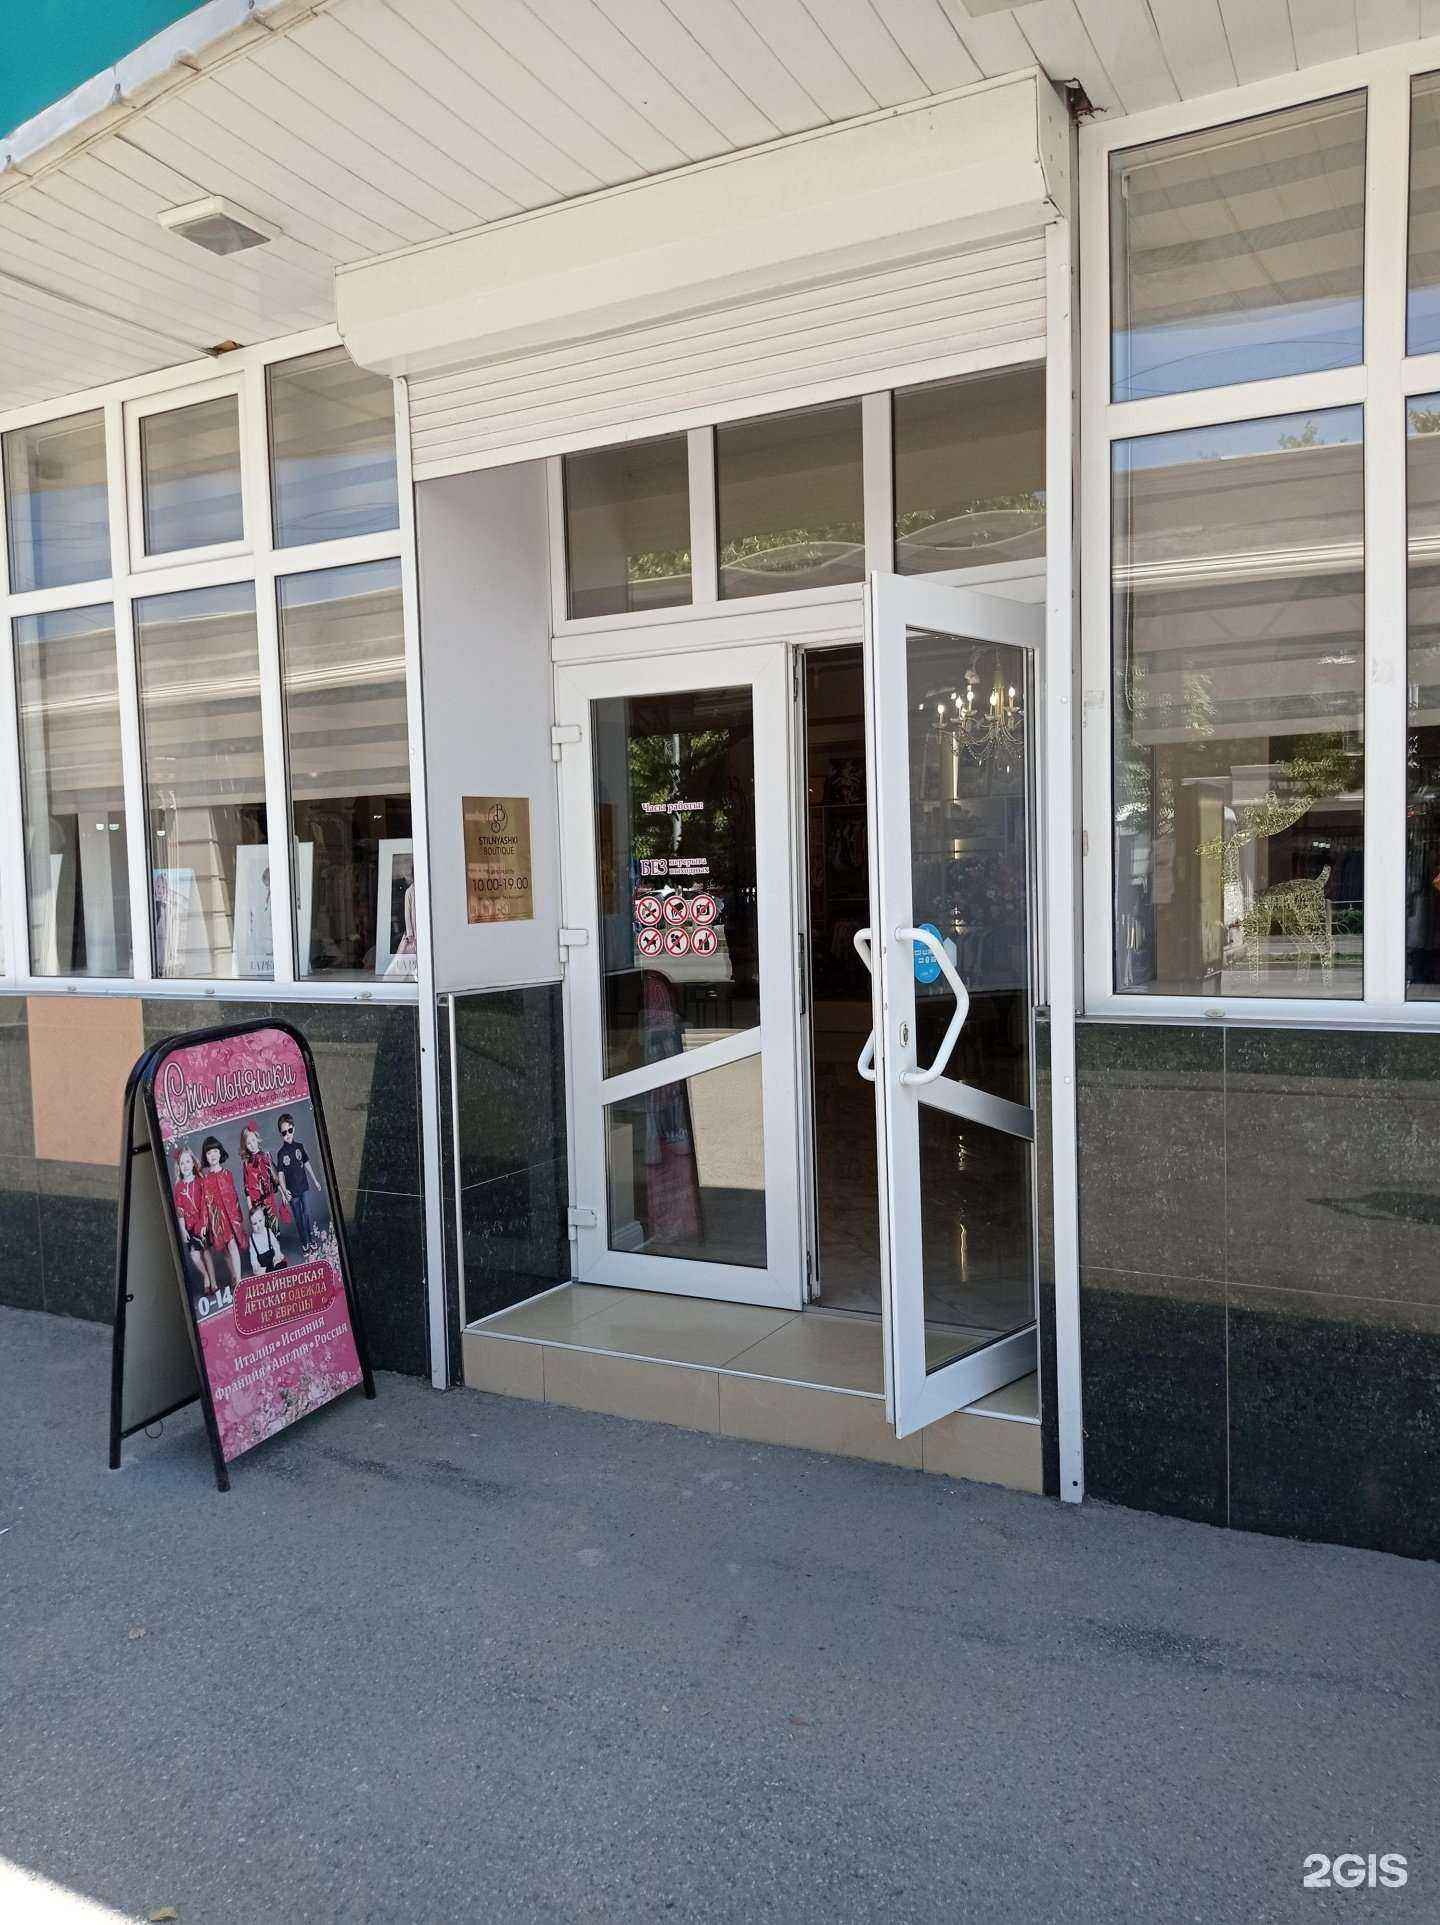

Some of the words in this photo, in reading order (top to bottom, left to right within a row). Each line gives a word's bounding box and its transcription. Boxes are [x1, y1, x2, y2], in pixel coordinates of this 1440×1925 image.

[483, 846, 516, 856] BOUTIQUE
[640, 858, 668, 876] БЕЗ
[245, 1266, 325, 1301] ДИЗАЙНЕРСКАЯ
[198, 1286, 233, 1316] 0-14
[244, 1291, 287, 1317] ДЕТСКАЯ
[288, 1281, 328, 1301] ОДЕЖДА
[275, 1298, 314, 1319] ЕВРОПЫ
